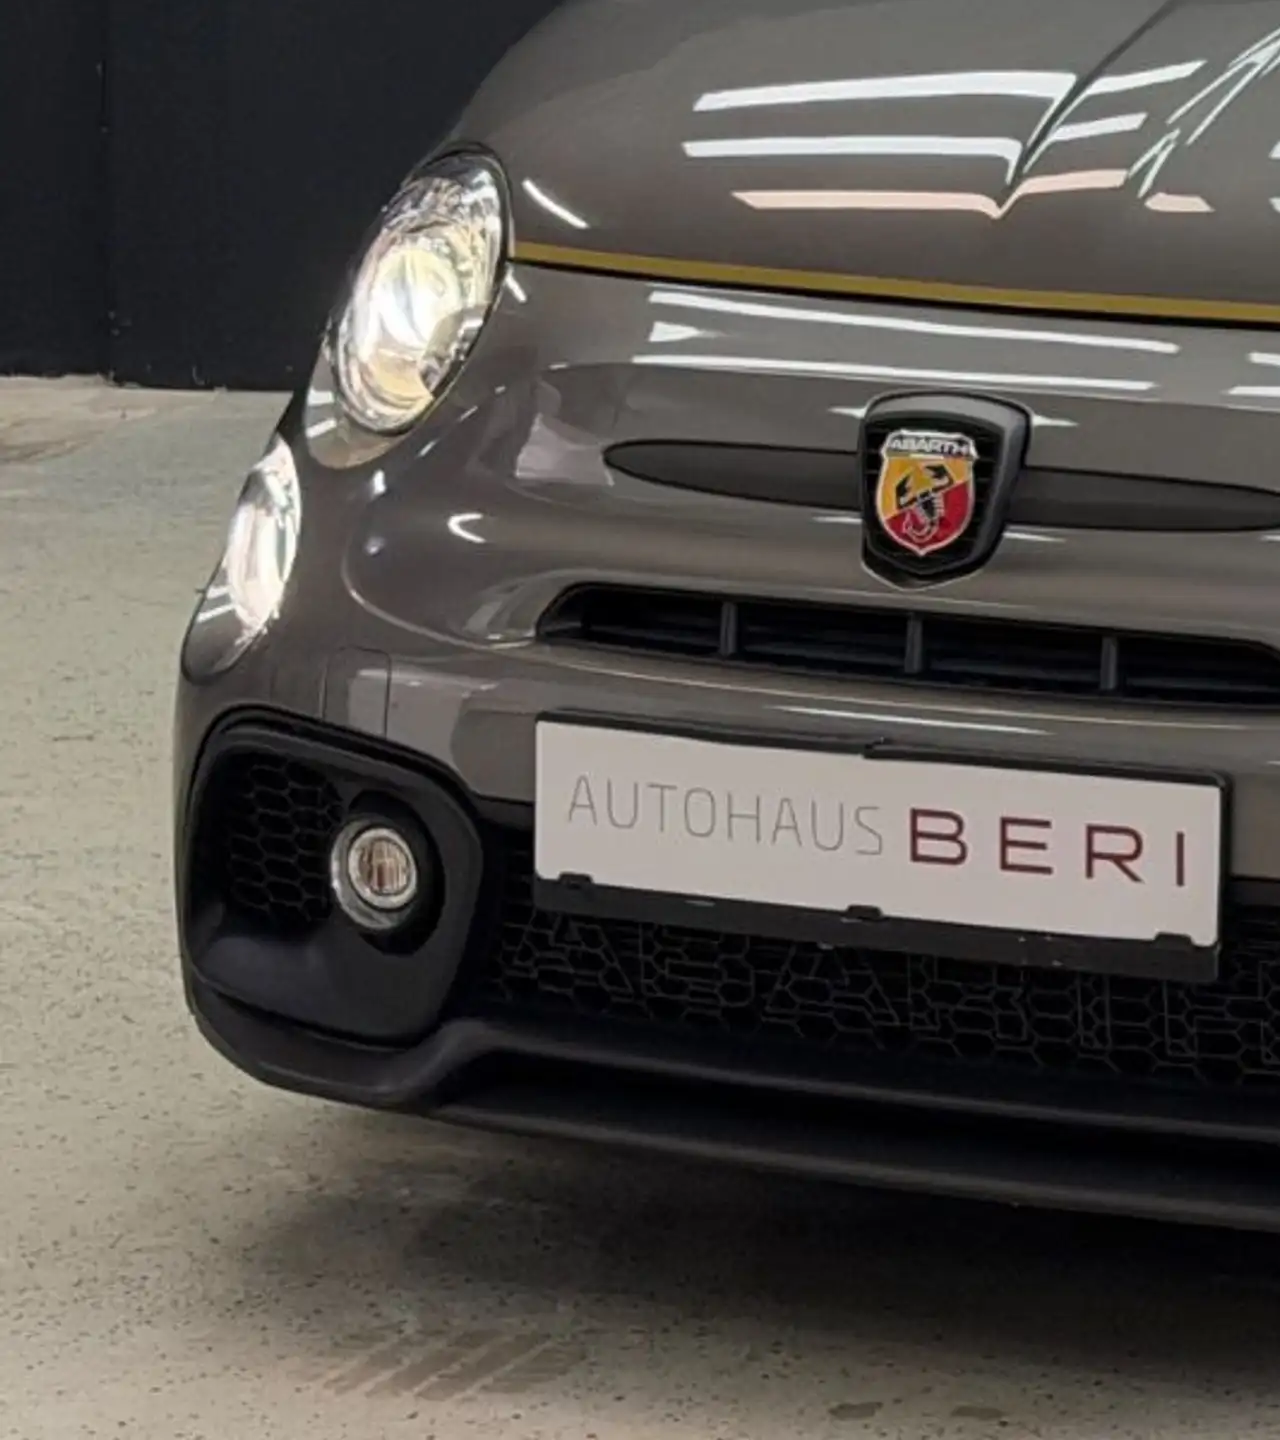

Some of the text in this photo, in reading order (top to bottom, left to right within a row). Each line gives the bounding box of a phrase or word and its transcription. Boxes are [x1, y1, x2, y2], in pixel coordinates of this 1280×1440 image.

[889, 437, 970, 455] ABARTH
[568, 774, 1185, 888] AUTOHAUS BERI
